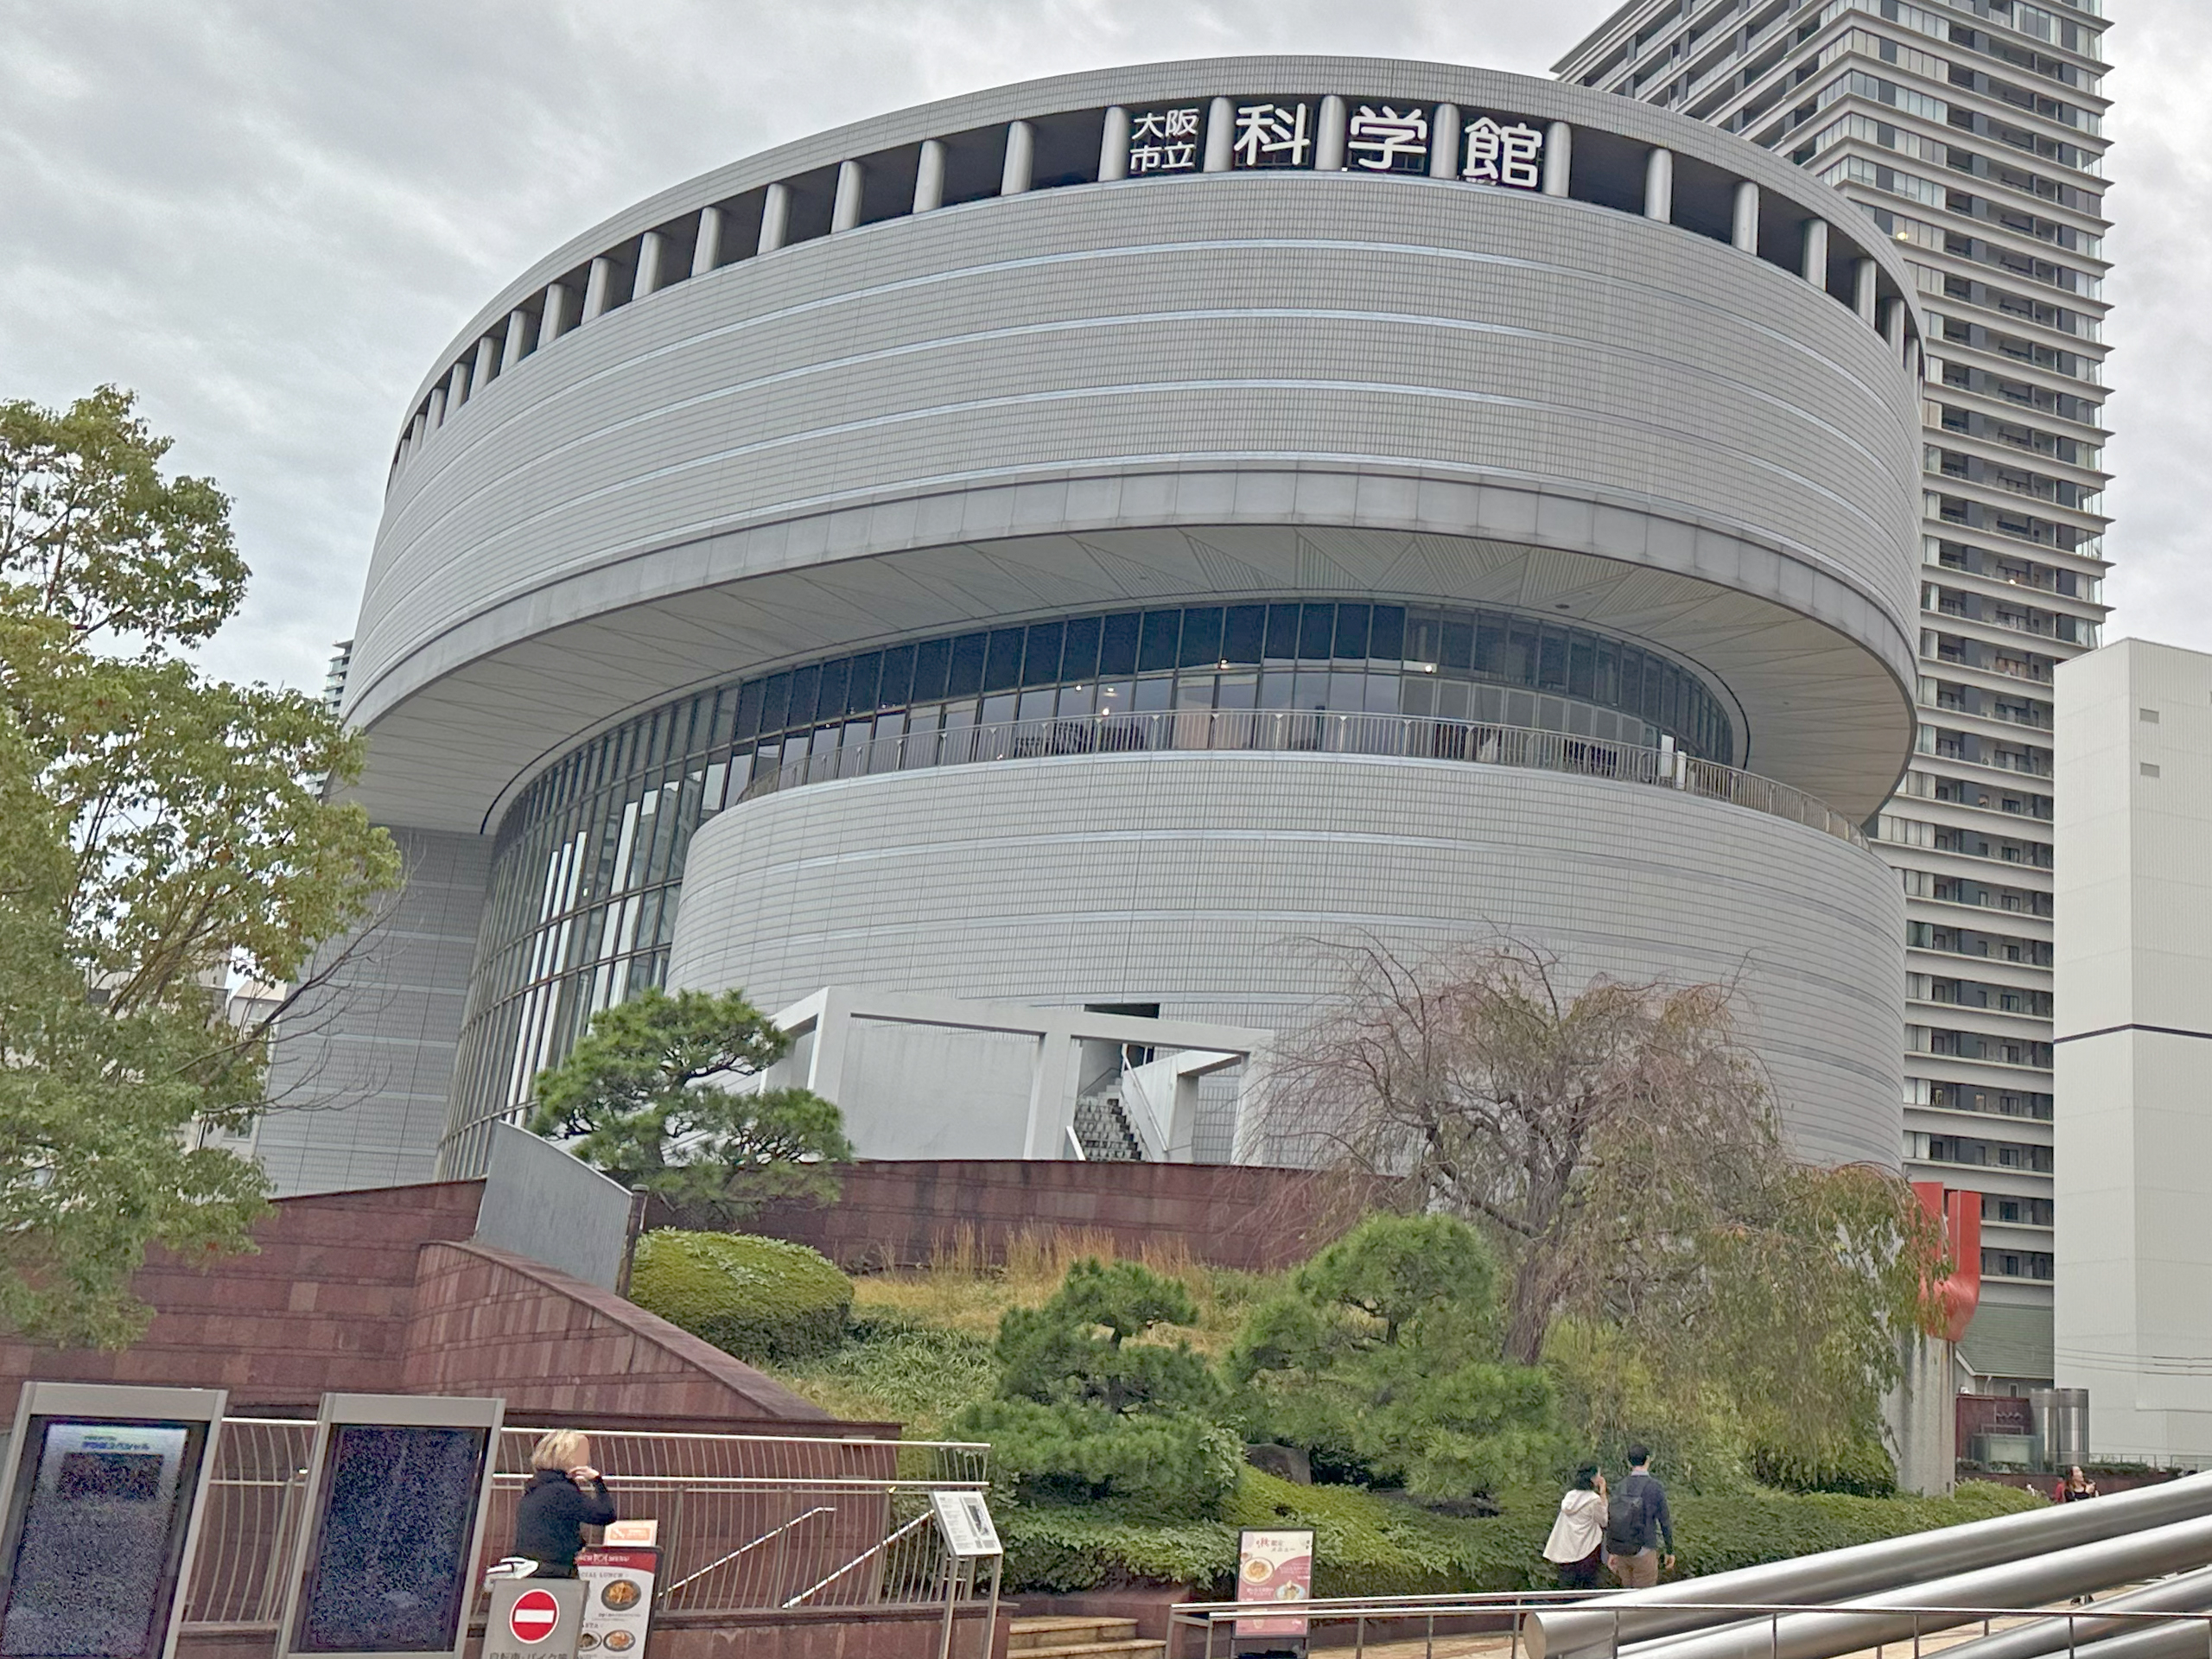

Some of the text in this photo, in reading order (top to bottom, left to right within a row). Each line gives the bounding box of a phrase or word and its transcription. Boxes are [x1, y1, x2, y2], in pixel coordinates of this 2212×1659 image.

[1131, 108, 1200, 140] 大阪
[1129, 141, 1196, 172] 市立
[1234, 102, 1542, 188] 科学館
